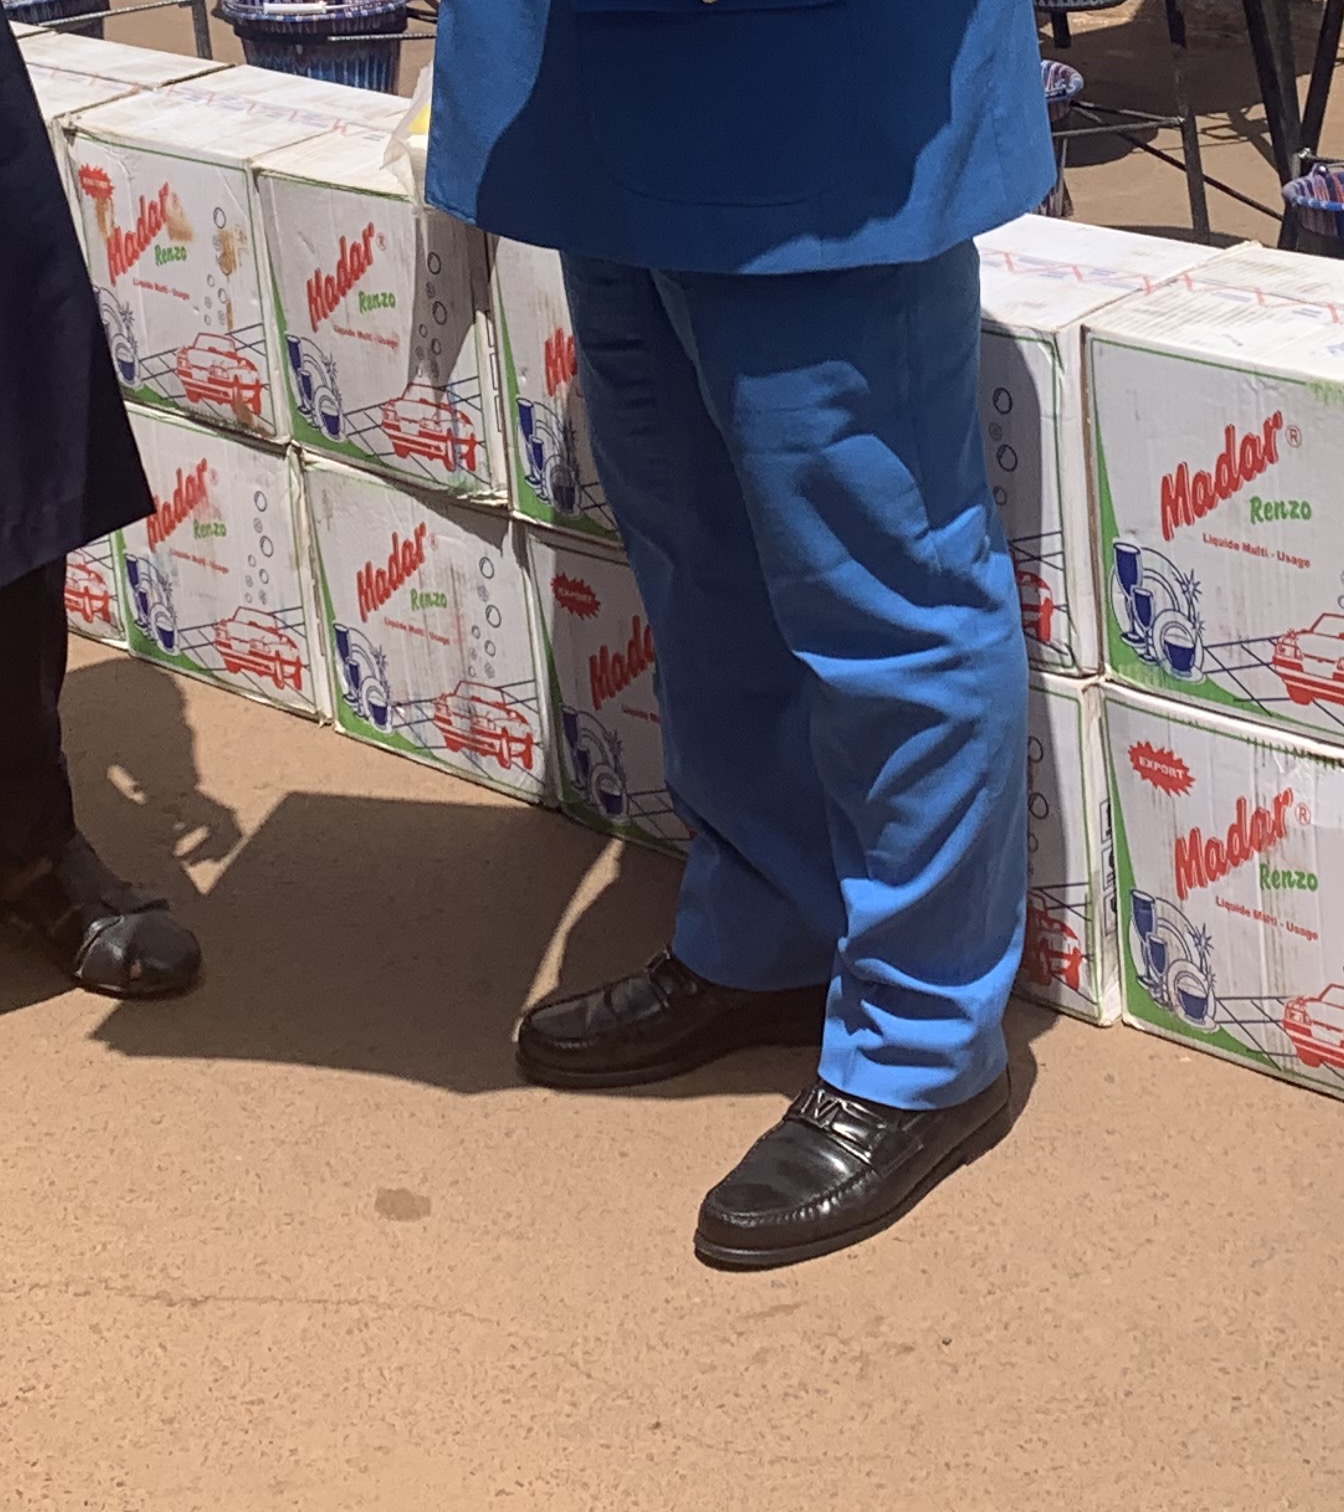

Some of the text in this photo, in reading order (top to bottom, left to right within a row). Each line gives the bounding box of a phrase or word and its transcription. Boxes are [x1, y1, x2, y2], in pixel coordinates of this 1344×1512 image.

[154, 244, 187, 267] Renzo
[358, 290, 396, 314] Renzo
[1160, 409, 1283, 542] Madar
[1249, 495, 1312, 525] Renzo
[1202, 533, 1310, 569] Liquide Multi Usage
[410, 588, 448, 611] Renzo
[1139, 755, 1185, 780] EXPORT
[1174, 787, 1294, 901] Madar
[1259, 863, 1319, 892] Renzo
[1215, 895, 1319, 942] Liquide Multi Usage
